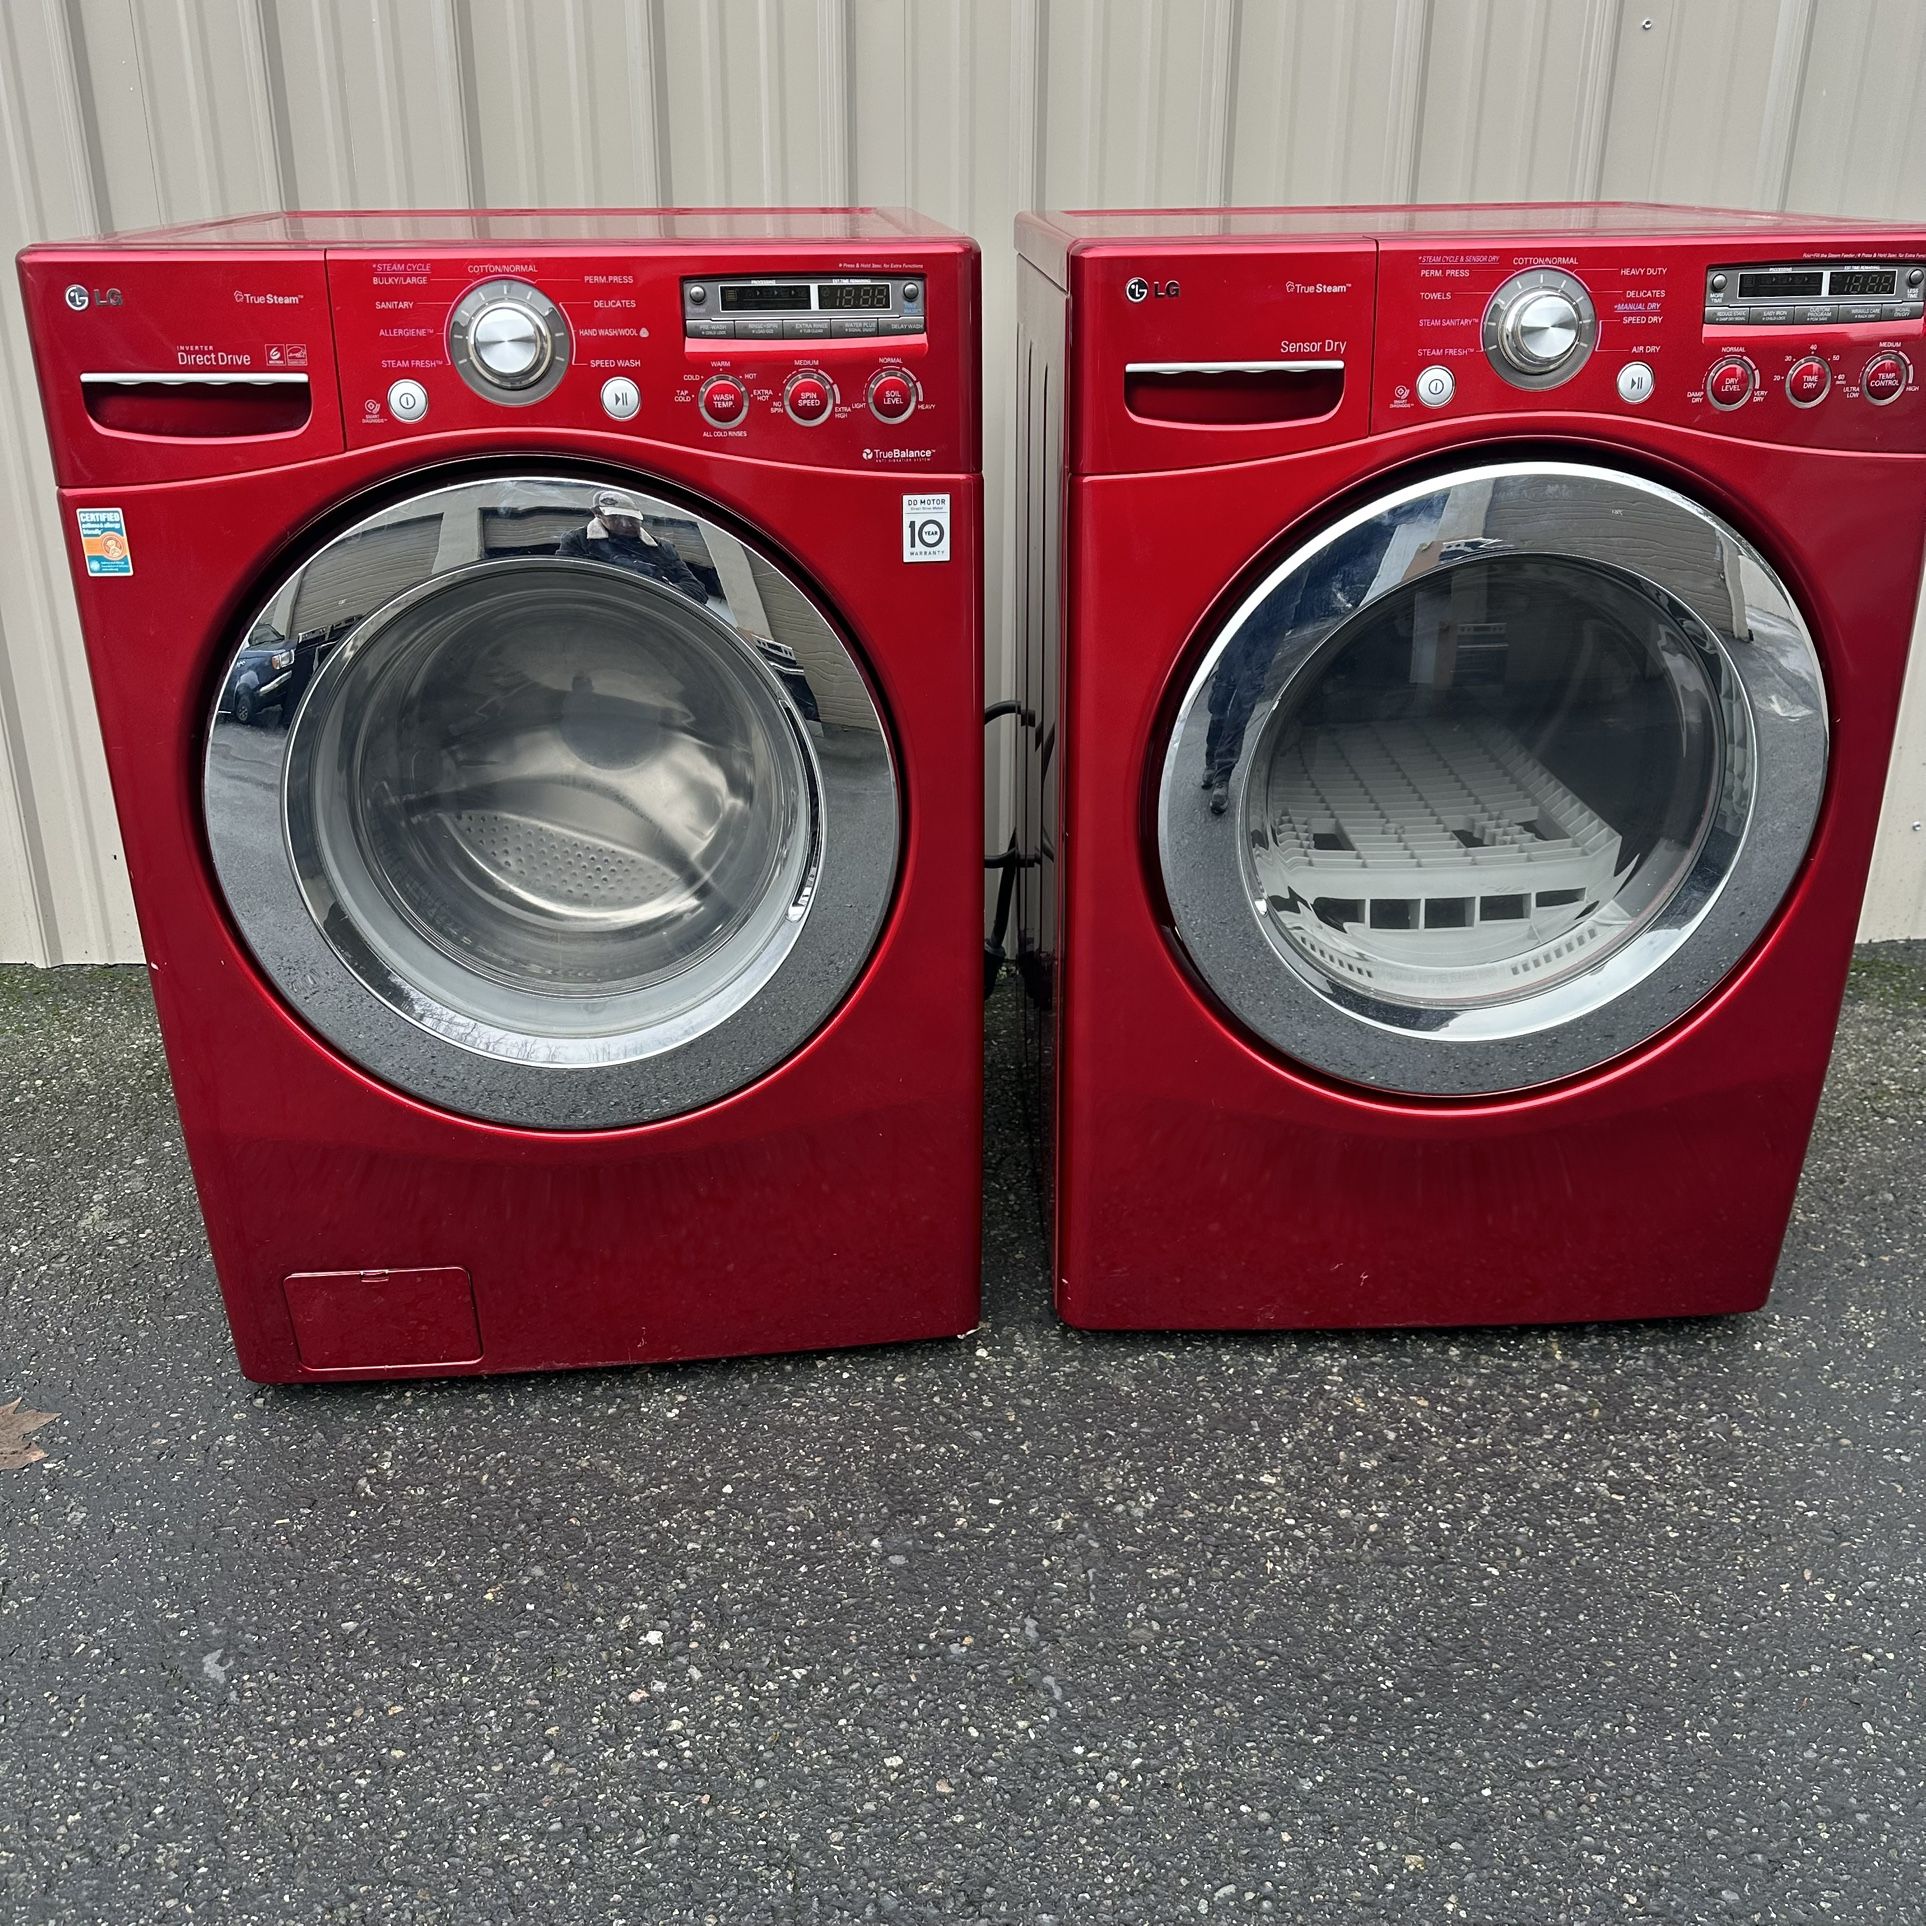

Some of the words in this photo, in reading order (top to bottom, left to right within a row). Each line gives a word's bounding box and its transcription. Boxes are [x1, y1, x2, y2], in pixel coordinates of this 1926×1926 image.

[1441, 256, 1459, 264] CYCLE
[1465, 256, 1484, 264] SENSOR
[1484, 256, 1500, 264] DRY
[1512, 256, 1579, 266] COTTON/NORMAL
[406, 263, 431, 272] CYCLE
[468, 264, 538, 274] COTTON/NORMAL
[1620, 267, 1645, 276] HEAVY
[1646, 267, 1668, 276] DUTY
[1420, 269, 1444, 278] PERM.
[1445, 269, 1470, 278] PRESS
[372, 276, 428, 285] BULKY/LARGE
[1153, 280, 1181, 298] LG
[94, 287, 123, 306] LG
[1420, 292, 1452, 300] TOWELS
[1626, 289, 1666, 299] DELICATES
[375, 301, 413, 310] SANITARY
[593, 300, 636, 308] DELICATES
[1646, 303, 1661, 311] DRY
[1419, 318, 1441, 327] STEAM
[1622, 316, 1646, 324] SPEED
[1646, 315, 1663, 324] DRY
[579, 328, 597, 337] HAND
[598, 328, 638, 337] WASH/WOOL
[1280, 340, 1323, 354] Sensor
[1324, 339, 1347, 355] Dry
[1631, 345, 1644, 354] AIR
[1644, 344, 1661, 354] DRY
[1417, 348, 1443, 357] STEAM
[178, 352, 216, 366] Direct
[218, 352, 251, 366] Drive
[381, 360, 408, 368] STEAM
[590, 360, 615, 368] SPEED
[616, 360, 641, 368] WASH
[1803, 374, 1819, 382] TIME
[1869, 379, 1899, 387] CONTROL
[1721, 384, 1741, 392] LEVEL
[885, 390, 901, 398] SOIL
[713, 401, 736, 409] TEMP.
[798, 399, 821, 407] SPEED
[883, 397, 904, 405] LEVEL
[728, 430, 748, 438] RINSES
[919, 498, 946, 506] MOTOR
[80, 512, 121, 523] CERTIFIED
[908, 519, 945, 549] 10
